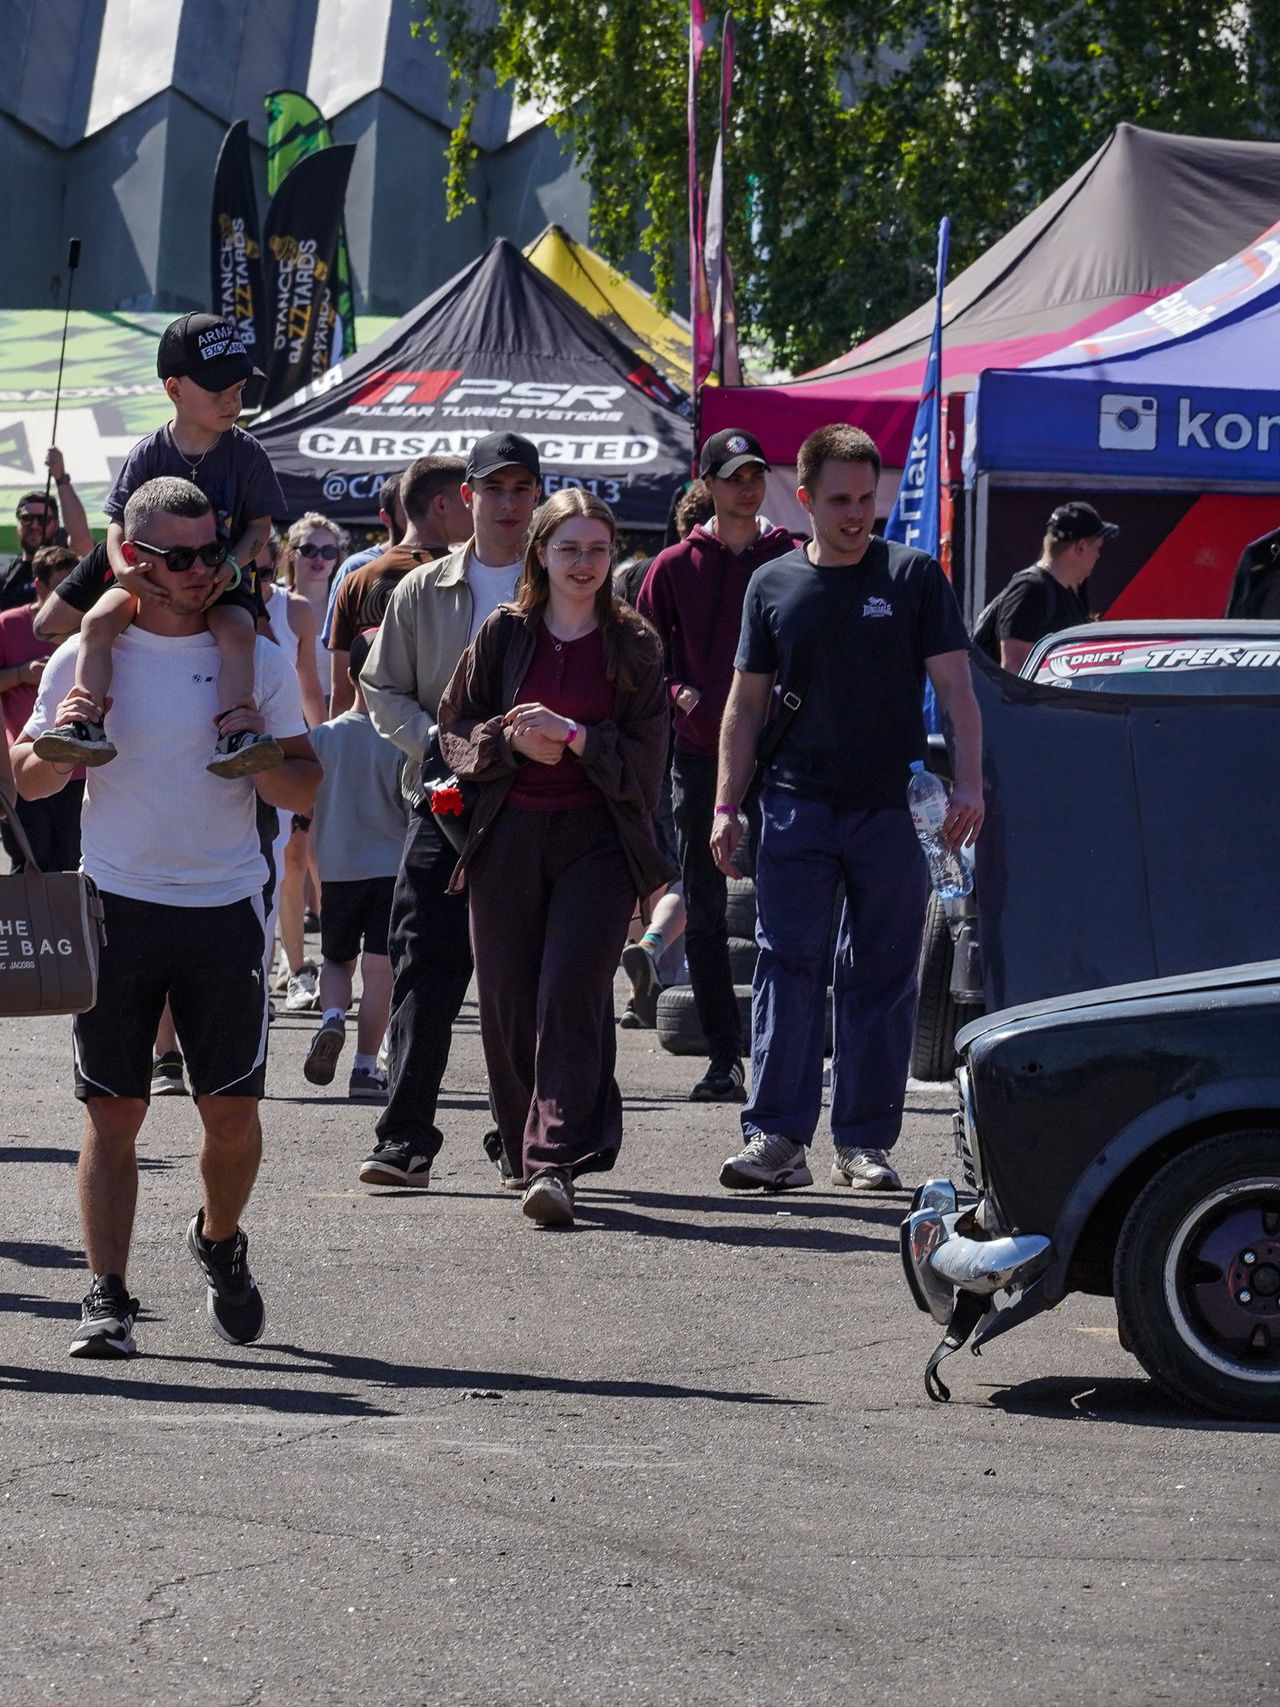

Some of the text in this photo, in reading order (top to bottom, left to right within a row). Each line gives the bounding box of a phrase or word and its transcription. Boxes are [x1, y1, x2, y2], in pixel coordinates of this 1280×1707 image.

[232, 217, 256, 344] BAZZTARDS
[443, 378, 626, 410] PSR
[345, 405, 624, 422] PULSAR TURBO SYSTEMS
[1070, 651, 1122, 665] DRIFT
[22, 939, 72, 956] BAG
[9, 960, 35, 970] JACOBS
